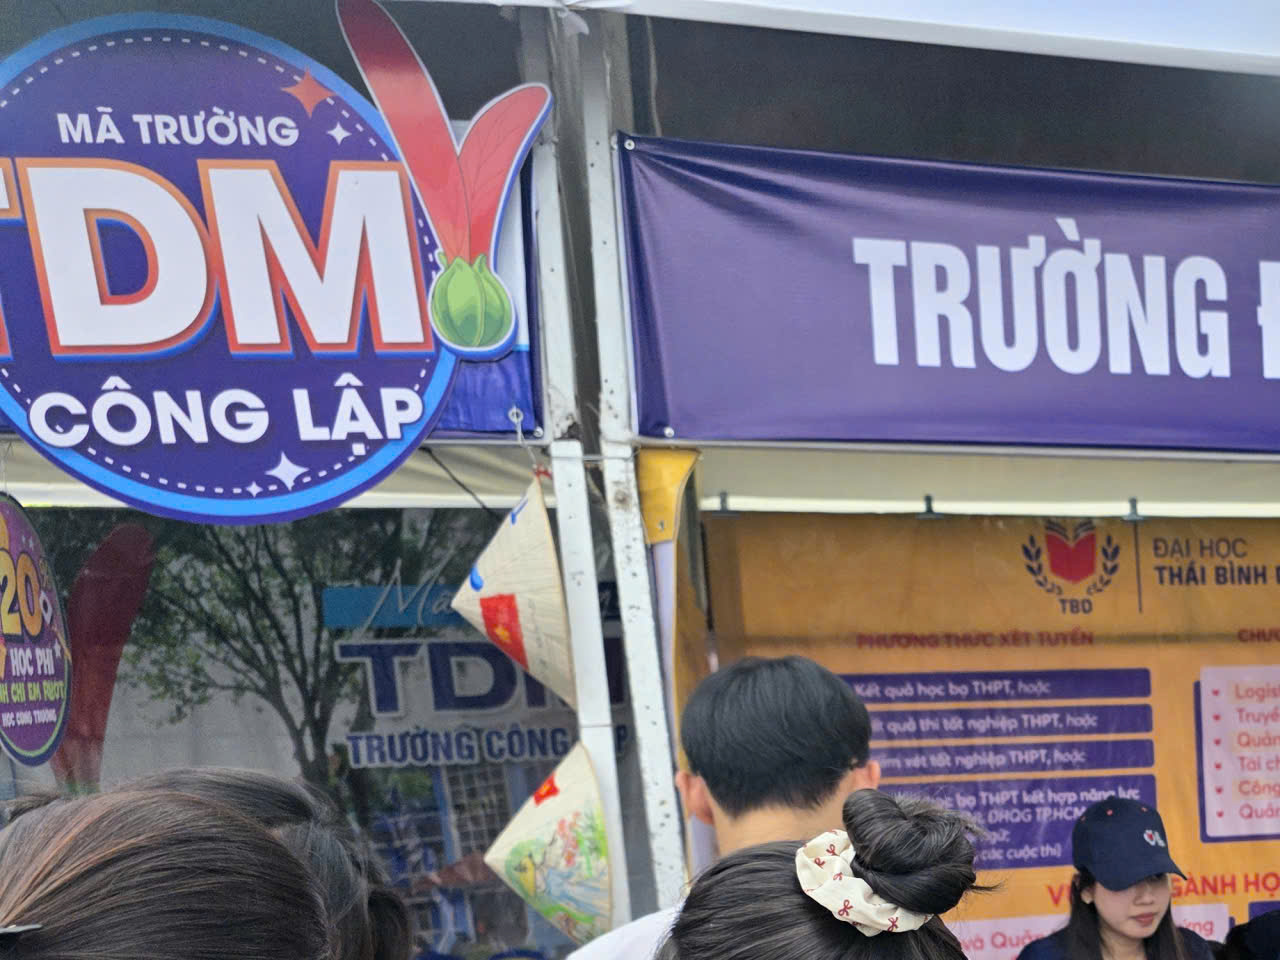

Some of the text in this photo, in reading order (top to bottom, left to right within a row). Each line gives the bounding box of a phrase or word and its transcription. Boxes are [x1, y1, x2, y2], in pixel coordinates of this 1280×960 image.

[57, 106, 299, 146] MÃ TRƯỜNG
[853, 216, 1231, 378] TRƯỜNG
[28, 373, 424, 456] CÔNG LẬP
[1152, 537, 1248, 561] ĐẠI HỌC
[1153, 561, 1207, 586] THÁI
[1215, 562, 1267, 585] BÌNH
[346, 725, 479, 766] TRƯỜNG
[484, 722, 570, 761] CÔNG
[1171, 869, 1236, 898] GÀNH
